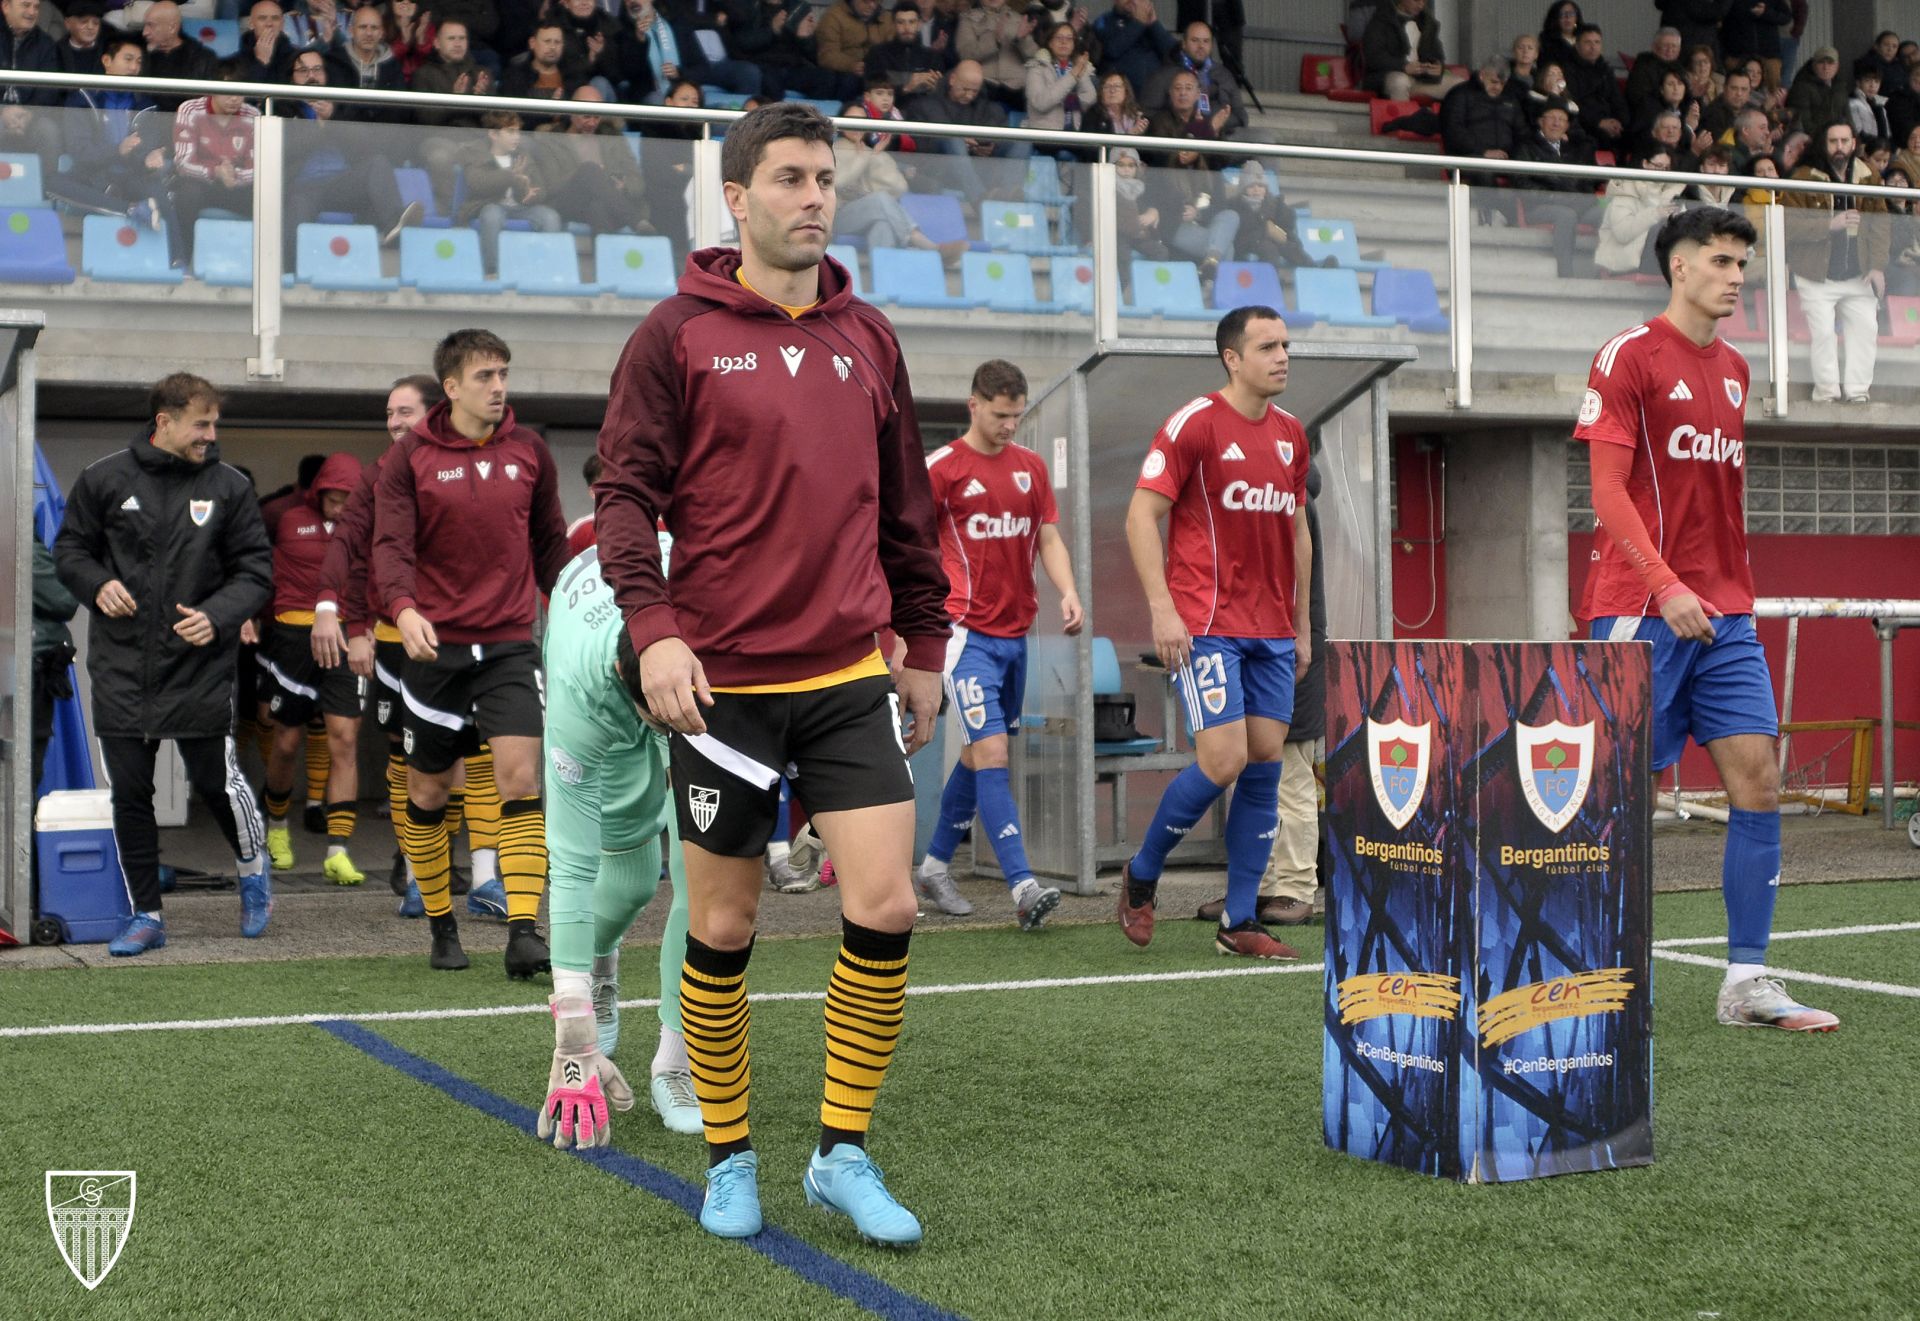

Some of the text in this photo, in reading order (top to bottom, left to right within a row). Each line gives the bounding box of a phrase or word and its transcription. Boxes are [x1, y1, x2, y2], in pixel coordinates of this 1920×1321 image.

[711, 352, 758, 375] 1928
[1667, 424, 1743, 468] Calvo
[436, 466, 464, 482] 1928
[1222, 480, 1297, 517] Calvo
[1196, 652, 1228, 689] 21
[956, 676, 985, 708] 16
[1389, 775, 1409, 796] FC
[1544, 777, 1569, 797] FC
[1355, 835, 1443, 865] Bergantiños
[1501, 842, 1610, 869] Bergantiños
[1422, 865, 1443, 876] club
[1585, 862, 1610, 873] club
[1377, 976, 1418, 998] cen
[1530, 981, 1581, 1004] cen
[1356, 1041, 1444, 1073] #CenBergantiños
[1503, 1051, 1614, 1075] #CenBergantiños
